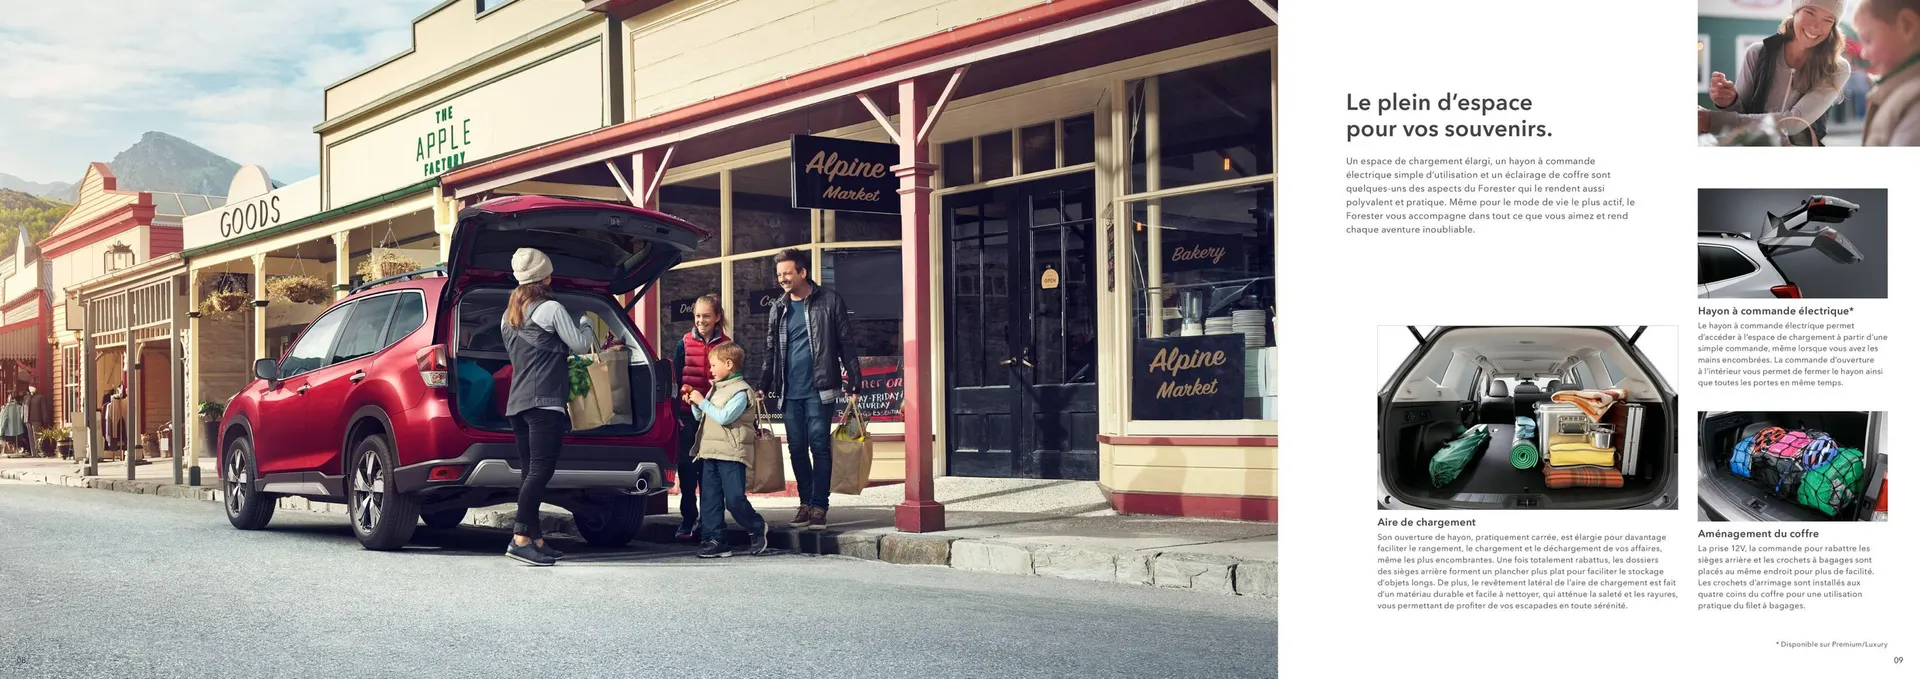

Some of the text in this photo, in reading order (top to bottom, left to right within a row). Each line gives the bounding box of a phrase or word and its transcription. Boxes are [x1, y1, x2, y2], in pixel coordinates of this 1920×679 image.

[436, 106, 453, 124] THE
[416, 118, 471, 162] APPLE
[424, 151, 465, 177] FACTORY
[805, 150, 886, 182] Alpine
[822, 185, 881, 202] Market
[220, 195, 281, 238] GOODS
[1171, 244, 1226, 265] Bakery
[680, 302, 694, 314] Del
[1149, 347, 1226, 378] Alpine
[1156, 378, 1218, 400] Market
